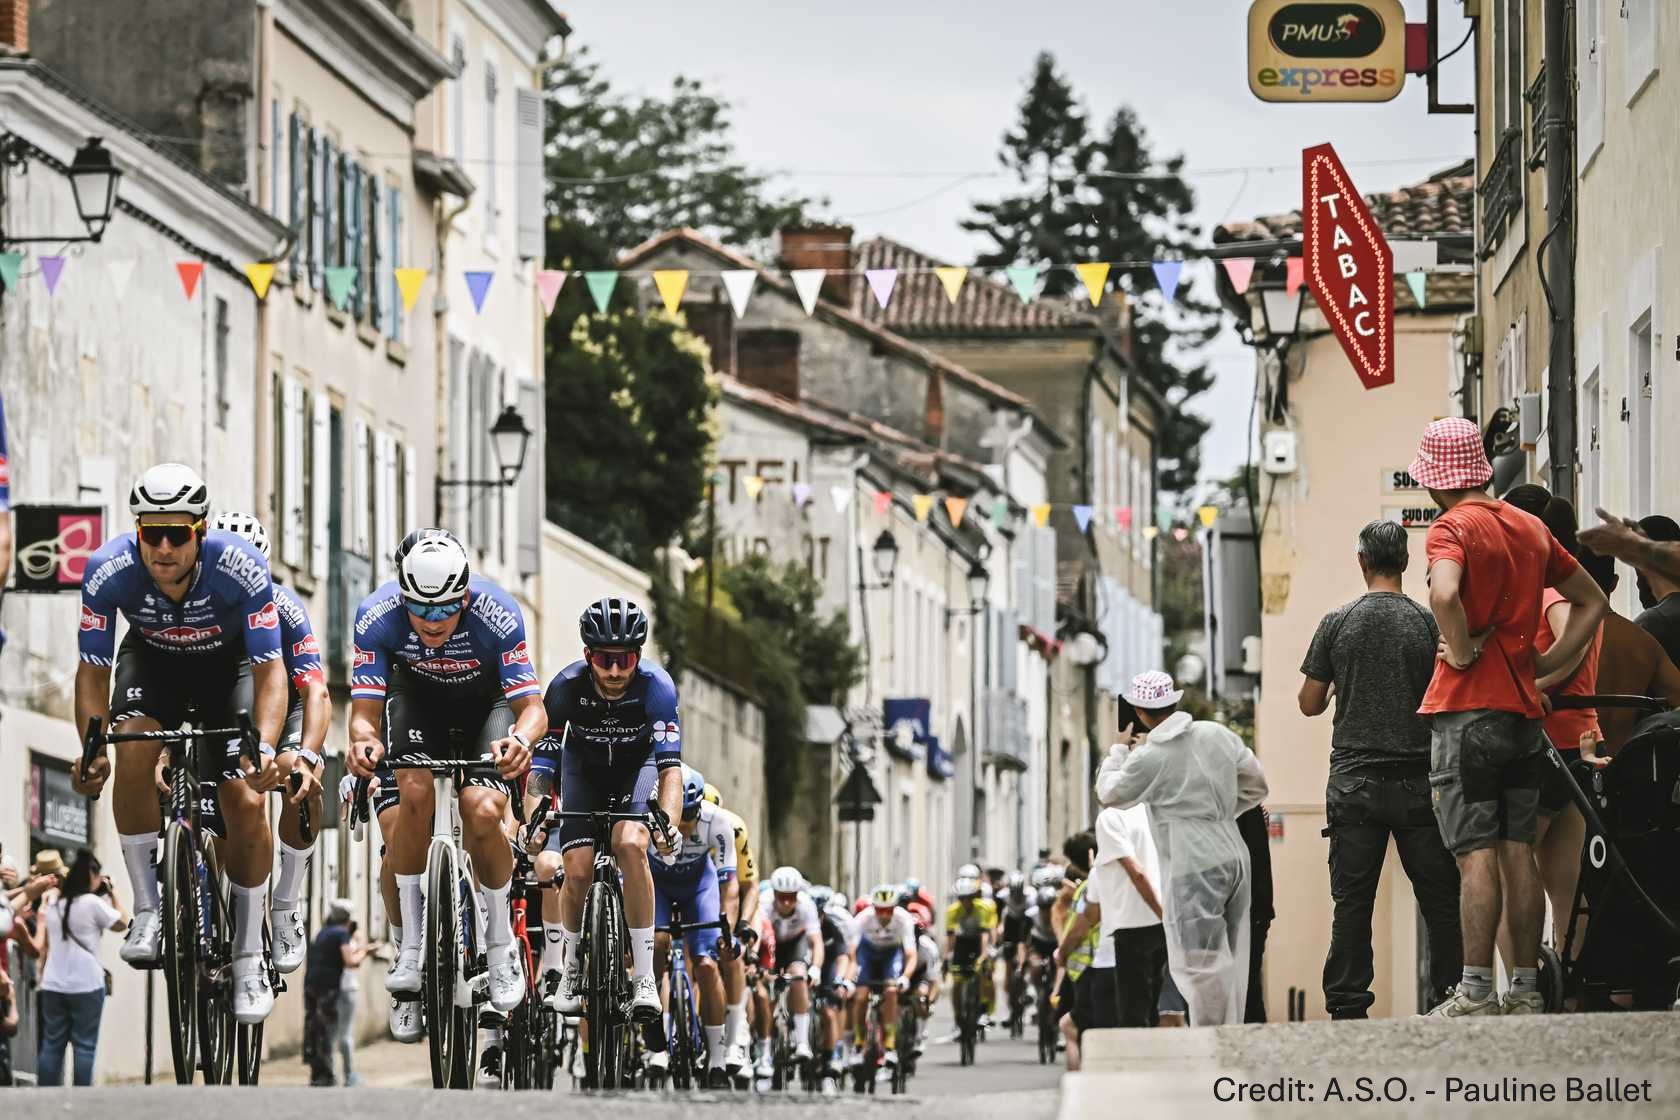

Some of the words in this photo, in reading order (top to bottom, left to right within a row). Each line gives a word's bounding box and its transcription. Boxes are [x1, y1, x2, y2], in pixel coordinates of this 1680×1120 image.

[1282, 24, 1334, 42] PMU
[1257, 67, 1397, 95] express
[1320, 192, 1376, 337] TABAC
[85, 550, 135, 597] deceuninck
[218, 544, 269, 594] Alpecin
[355, 593, 402, 636] deceuninck
[472, 592, 519, 636] Alpecin
[415, 661, 473, 673] Alpecin
